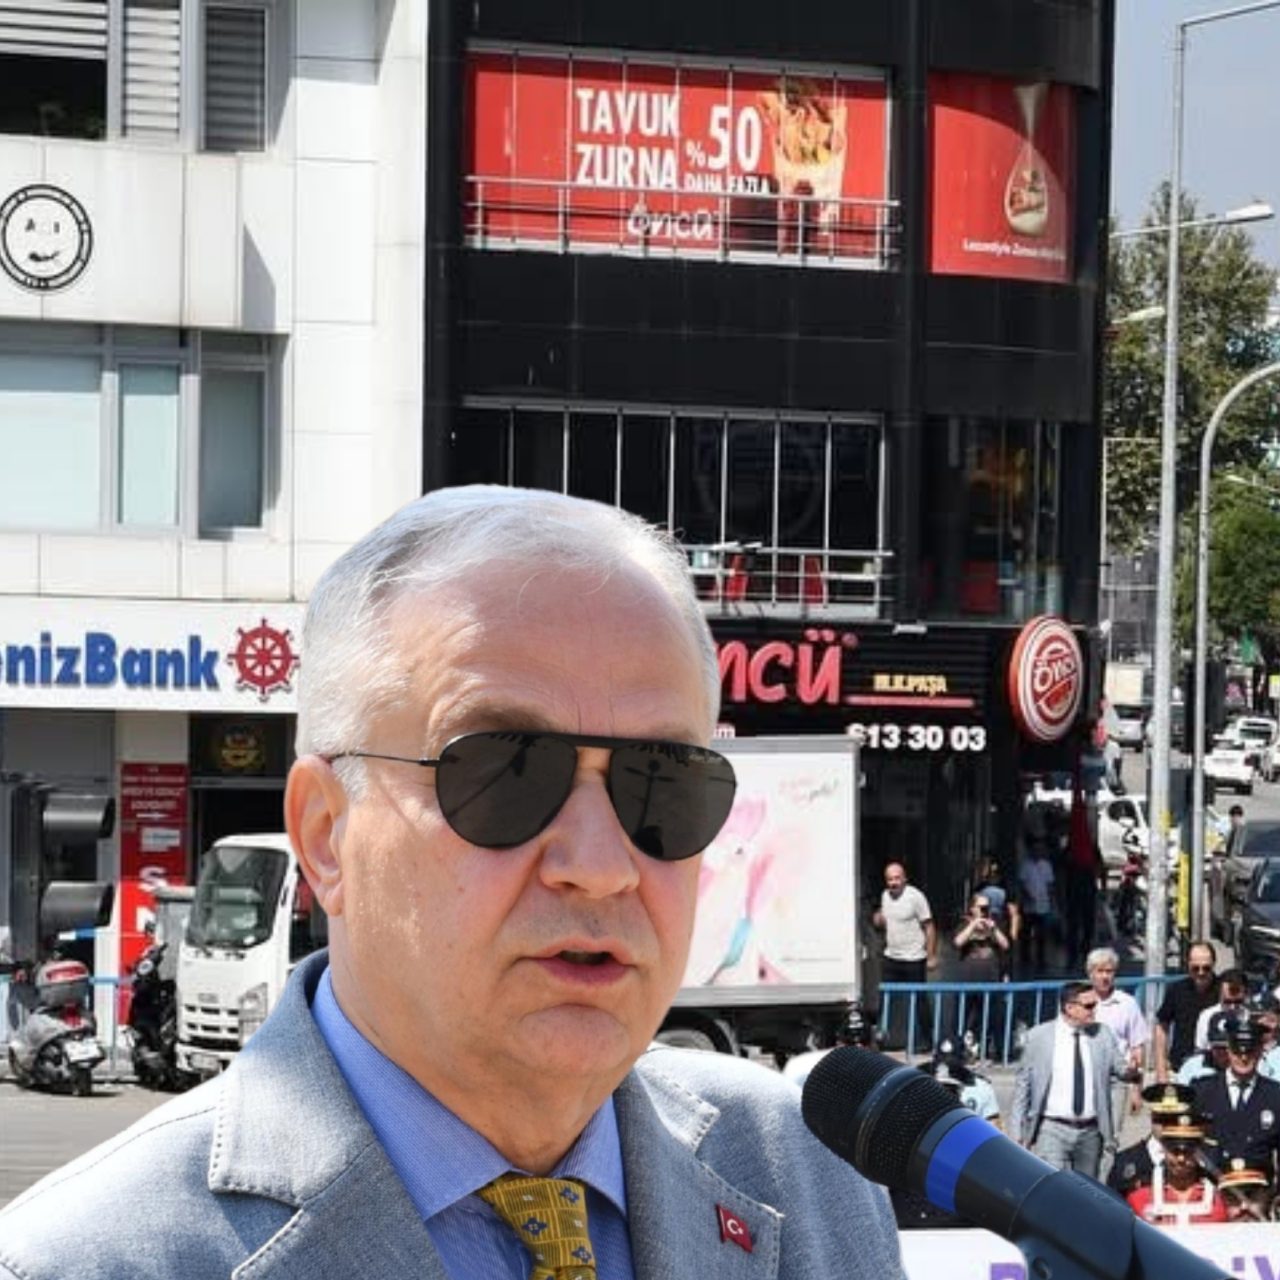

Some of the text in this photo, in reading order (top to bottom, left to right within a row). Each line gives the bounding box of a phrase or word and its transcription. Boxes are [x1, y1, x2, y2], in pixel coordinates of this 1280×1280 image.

[575, 87, 680, 138] TAVUK
[685, 104, 763, 172] %50
[575, 143, 679, 190] ZURNA
[0, 631, 220, 690] nizBank
[908, 724, 944, 750] 30
[951, 726, 987, 751] 03
